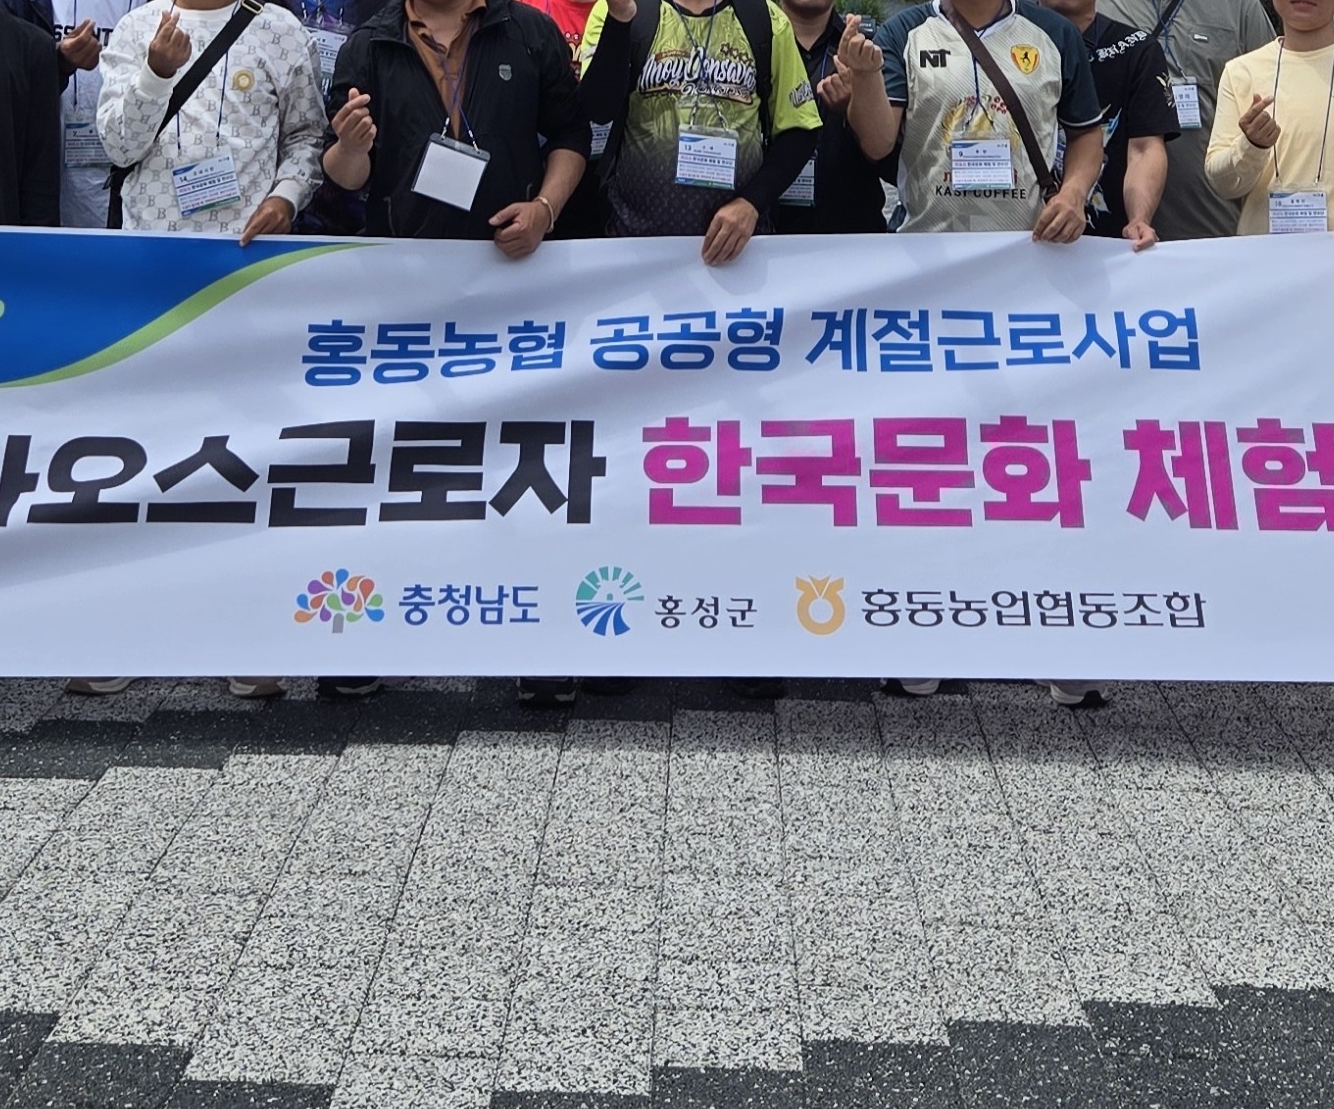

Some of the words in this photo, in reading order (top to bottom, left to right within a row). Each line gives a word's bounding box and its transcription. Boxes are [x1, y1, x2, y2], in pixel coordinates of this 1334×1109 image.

[973, 188, 1027, 199] COFFEE
[301, 317, 568, 388] 홍동농협
[588, 305, 786, 374] 공공형
[804, 305, 1201, 375] 계절근로사업
[644, 416, 1090, 527] 한국문화
[398, 583, 541, 626] 충청남도
[654, 594, 758, 629] 홍성군
[861, 588, 1206, 629] 홍동농업협동조합
